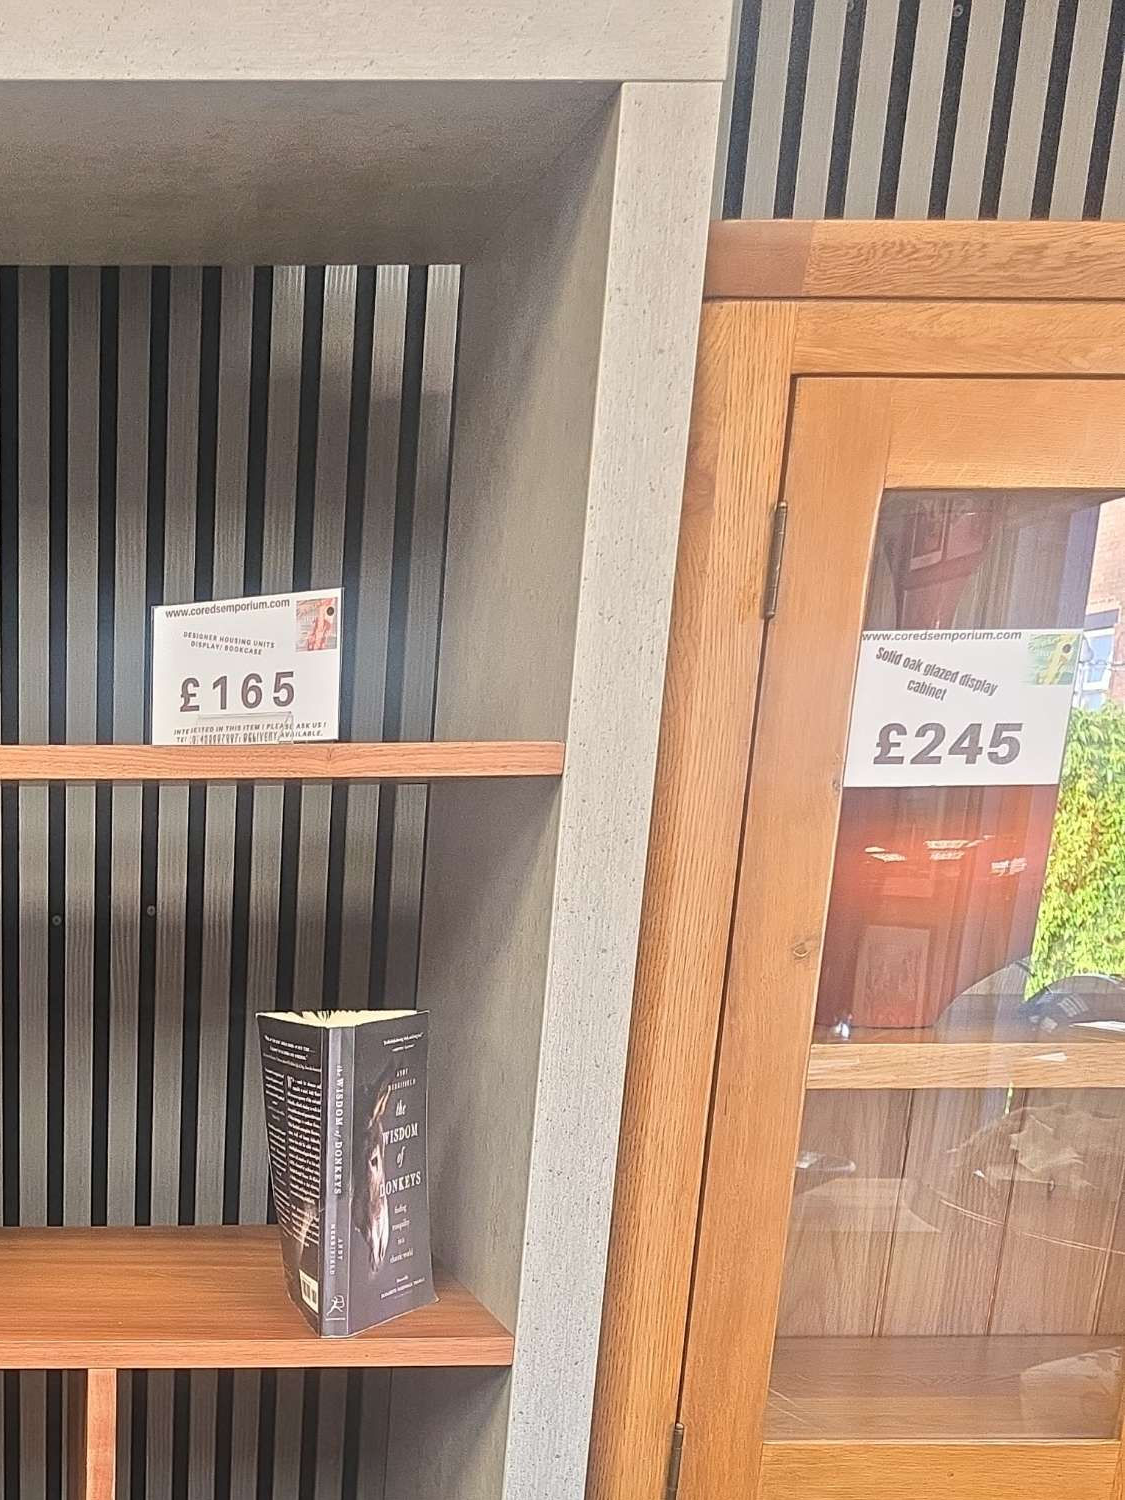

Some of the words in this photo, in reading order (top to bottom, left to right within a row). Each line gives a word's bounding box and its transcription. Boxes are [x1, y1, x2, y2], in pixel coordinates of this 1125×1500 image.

[165, 598, 290, 618] www.coredsemporium.com
[183, 631, 218, 642] DESIGNER
[219, 636, 252, 646] HOUSING
[253, 640, 276, 649] UNITS
[861, 630, 1022, 643] www.coredsemporium.com
[225, 644, 262, 656] BOOKCASE
[875, 647, 903, 666] Solid
[902, 656, 923, 673] oak
[923, 662, 960, 682] glazed
[959, 673, 998, 697] display
[179, 671, 295, 713] £165
[906, 678, 948, 701] cabinet
[873, 722, 1023, 766] £245
[335, 1078, 344, 1126] WISDOM
[395, 1099, 407, 1117] the
[382, 1122, 419, 1146] WISDOM
[334, 1141, 343, 1195] DONKEYS
[396, 1146, 406, 1169] of
[379, 1171, 422, 1198] DONKEYS
